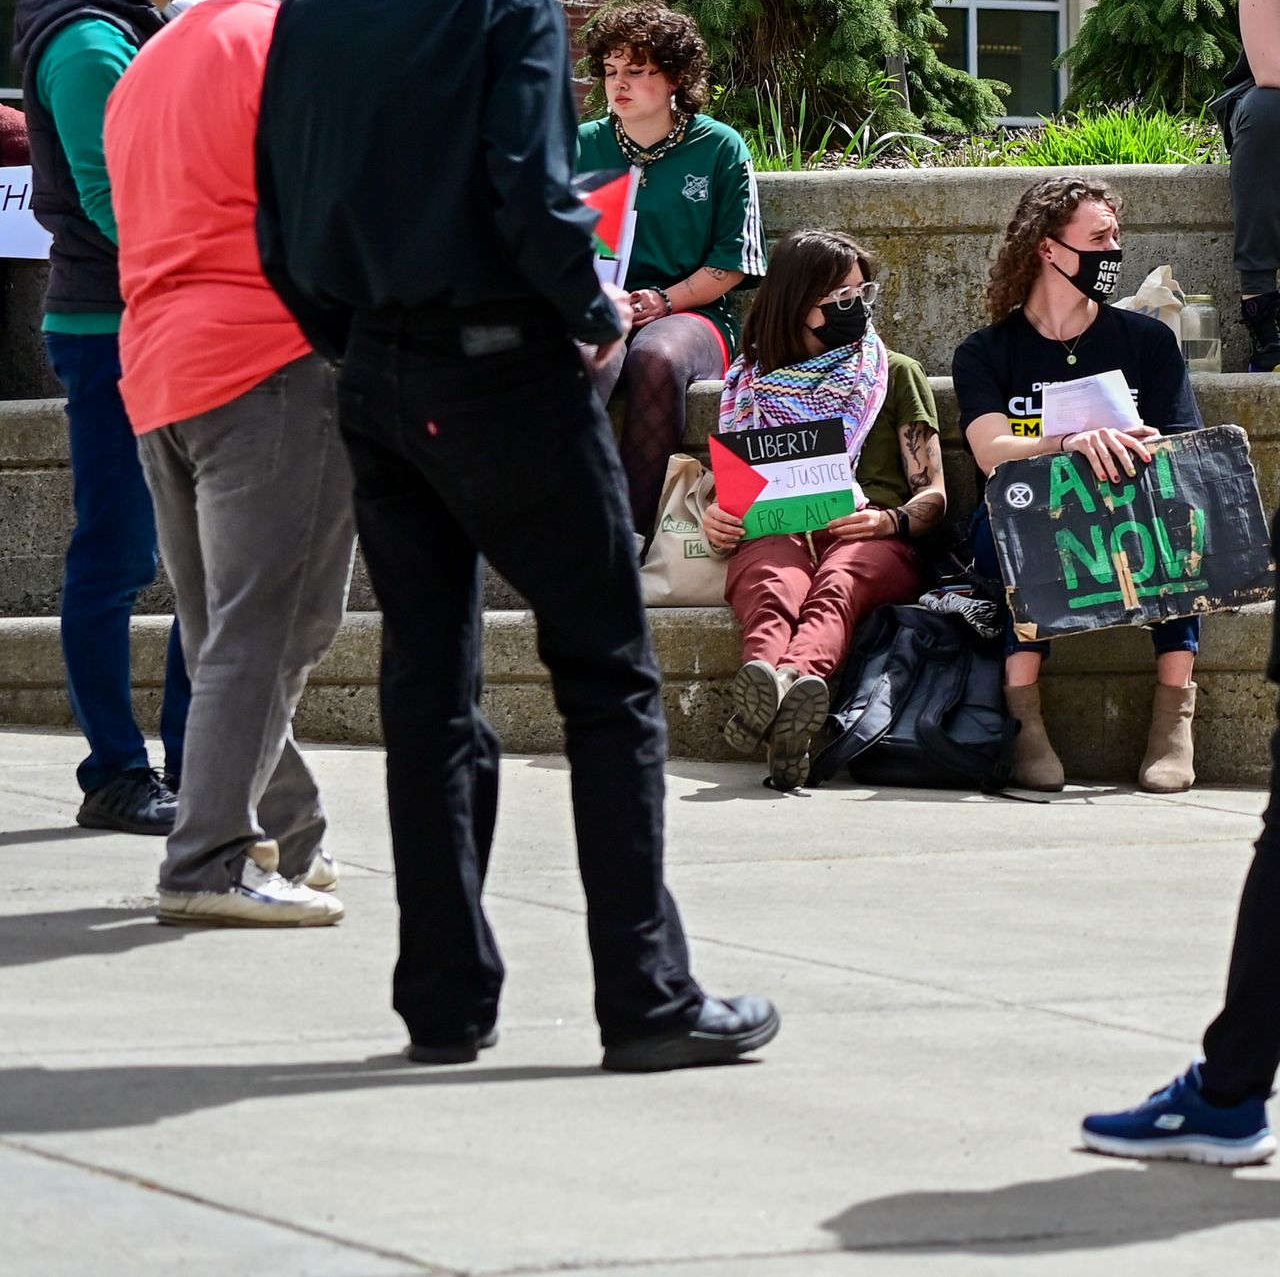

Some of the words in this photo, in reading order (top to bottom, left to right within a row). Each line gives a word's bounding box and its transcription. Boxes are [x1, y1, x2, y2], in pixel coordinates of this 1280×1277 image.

[1099, 260, 1122, 272] GRE
[1093, 281, 1115, 294] DEA
[1011, 421, 1040, 436] EM
[736, 429, 819, 461] "LIBERTY
[786, 463, 849, 489] JUSTICE
[756, 507, 792, 533] FOR
[805, 497, 838, 528] ALL"
[1055, 508, 1206, 590] NOW
